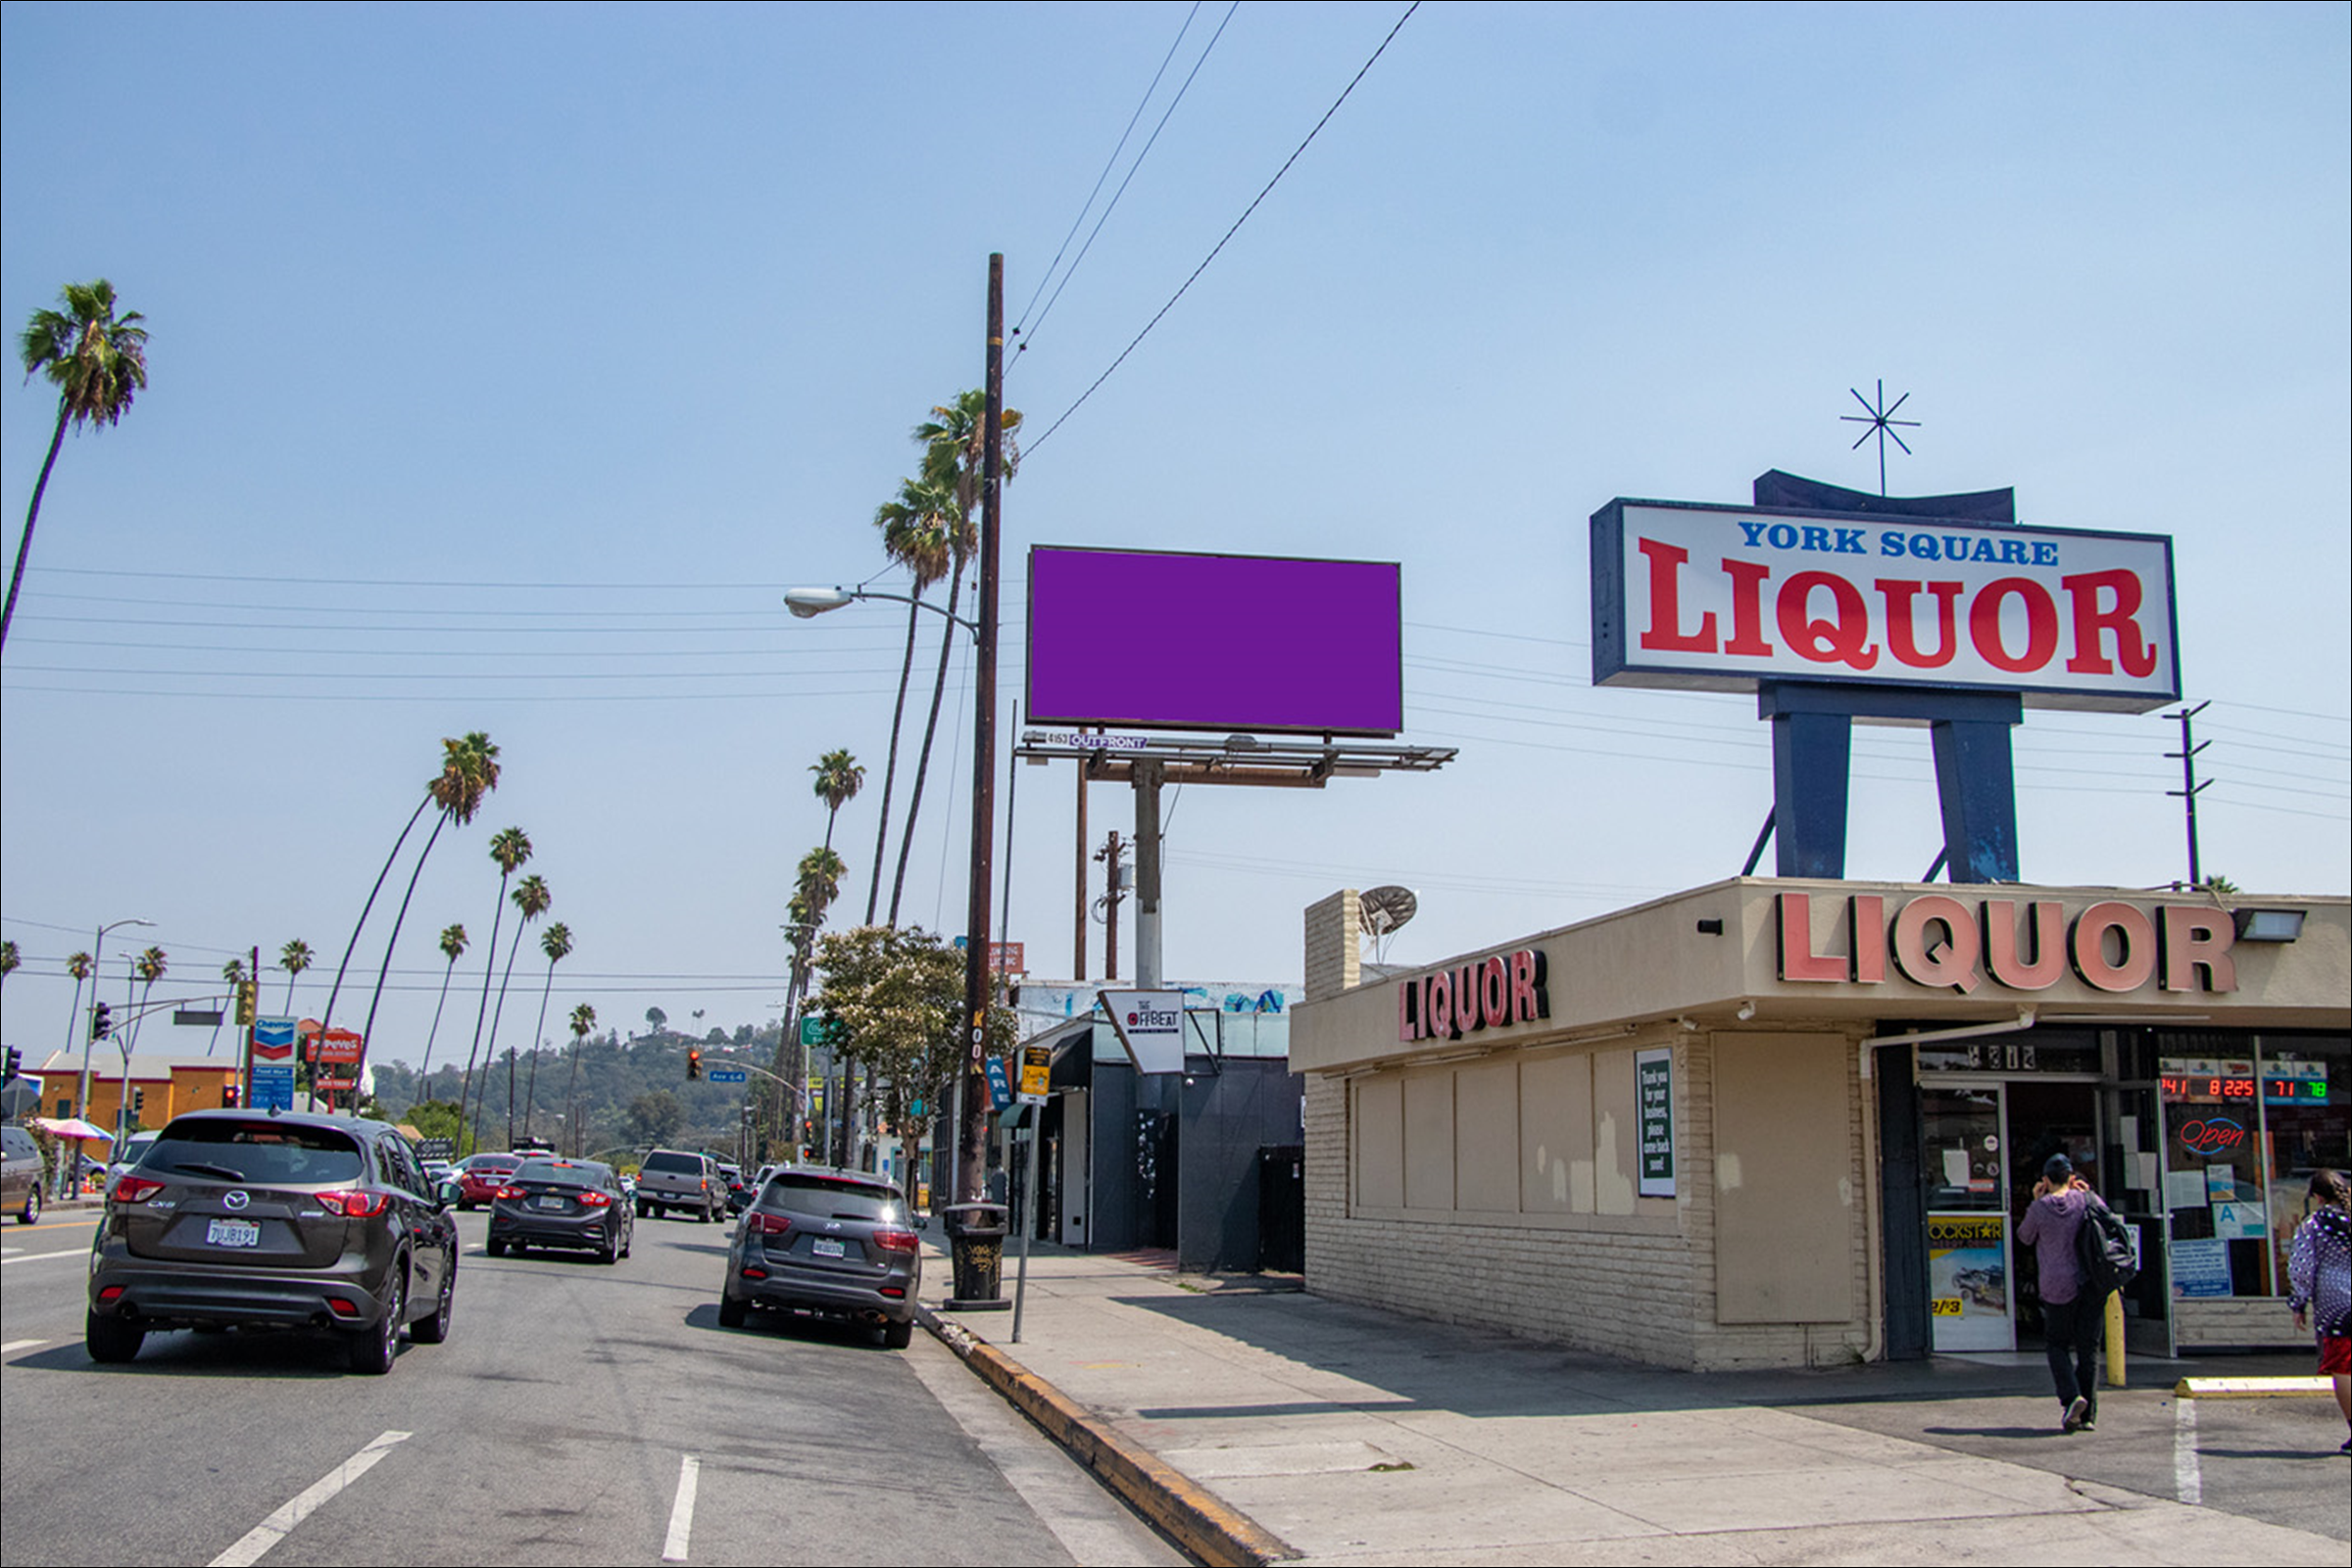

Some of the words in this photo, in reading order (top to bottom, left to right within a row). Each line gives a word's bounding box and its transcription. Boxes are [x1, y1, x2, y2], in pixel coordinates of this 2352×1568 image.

[1739, 521, 1868, 556] YORK
[1881, 531, 2059, 567] SQUARE
[1638, 537, 2157, 678] LIQUOR
[1071, 734, 1145, 748] OUTFRONT
[1776, 892, 2238, 995] LIQUOR
[1398, 949, 1548, 1042] LIQUOR
[1138, 1001, 1152, 1010] THE
[256, 1019, 294, 1029] Chevron
[1127, 1010, 1179, 1027] OFFBEAT
[310, 1039, 358, 1050] PPEYES
[712, 1071, 727, 1080] Ave
[1642, 1069, 1657, 1085] Thank
[1657, 1071, 1668, 1087] you
[2210, 1080, 2222, 1096] 8
[2224, 1080, 2254, 1097] 225
[2276, 1081, 2295, 1097] 71
[2308, 1082, 2328, 1098] 78
[1653, 1090, 1666, 1107] your
[2180, 1120, 2244, 1149] Open
[2220, 1204, 2236, 1222] A
[1928, 1222, 2002, 1240] OCKSTAR
